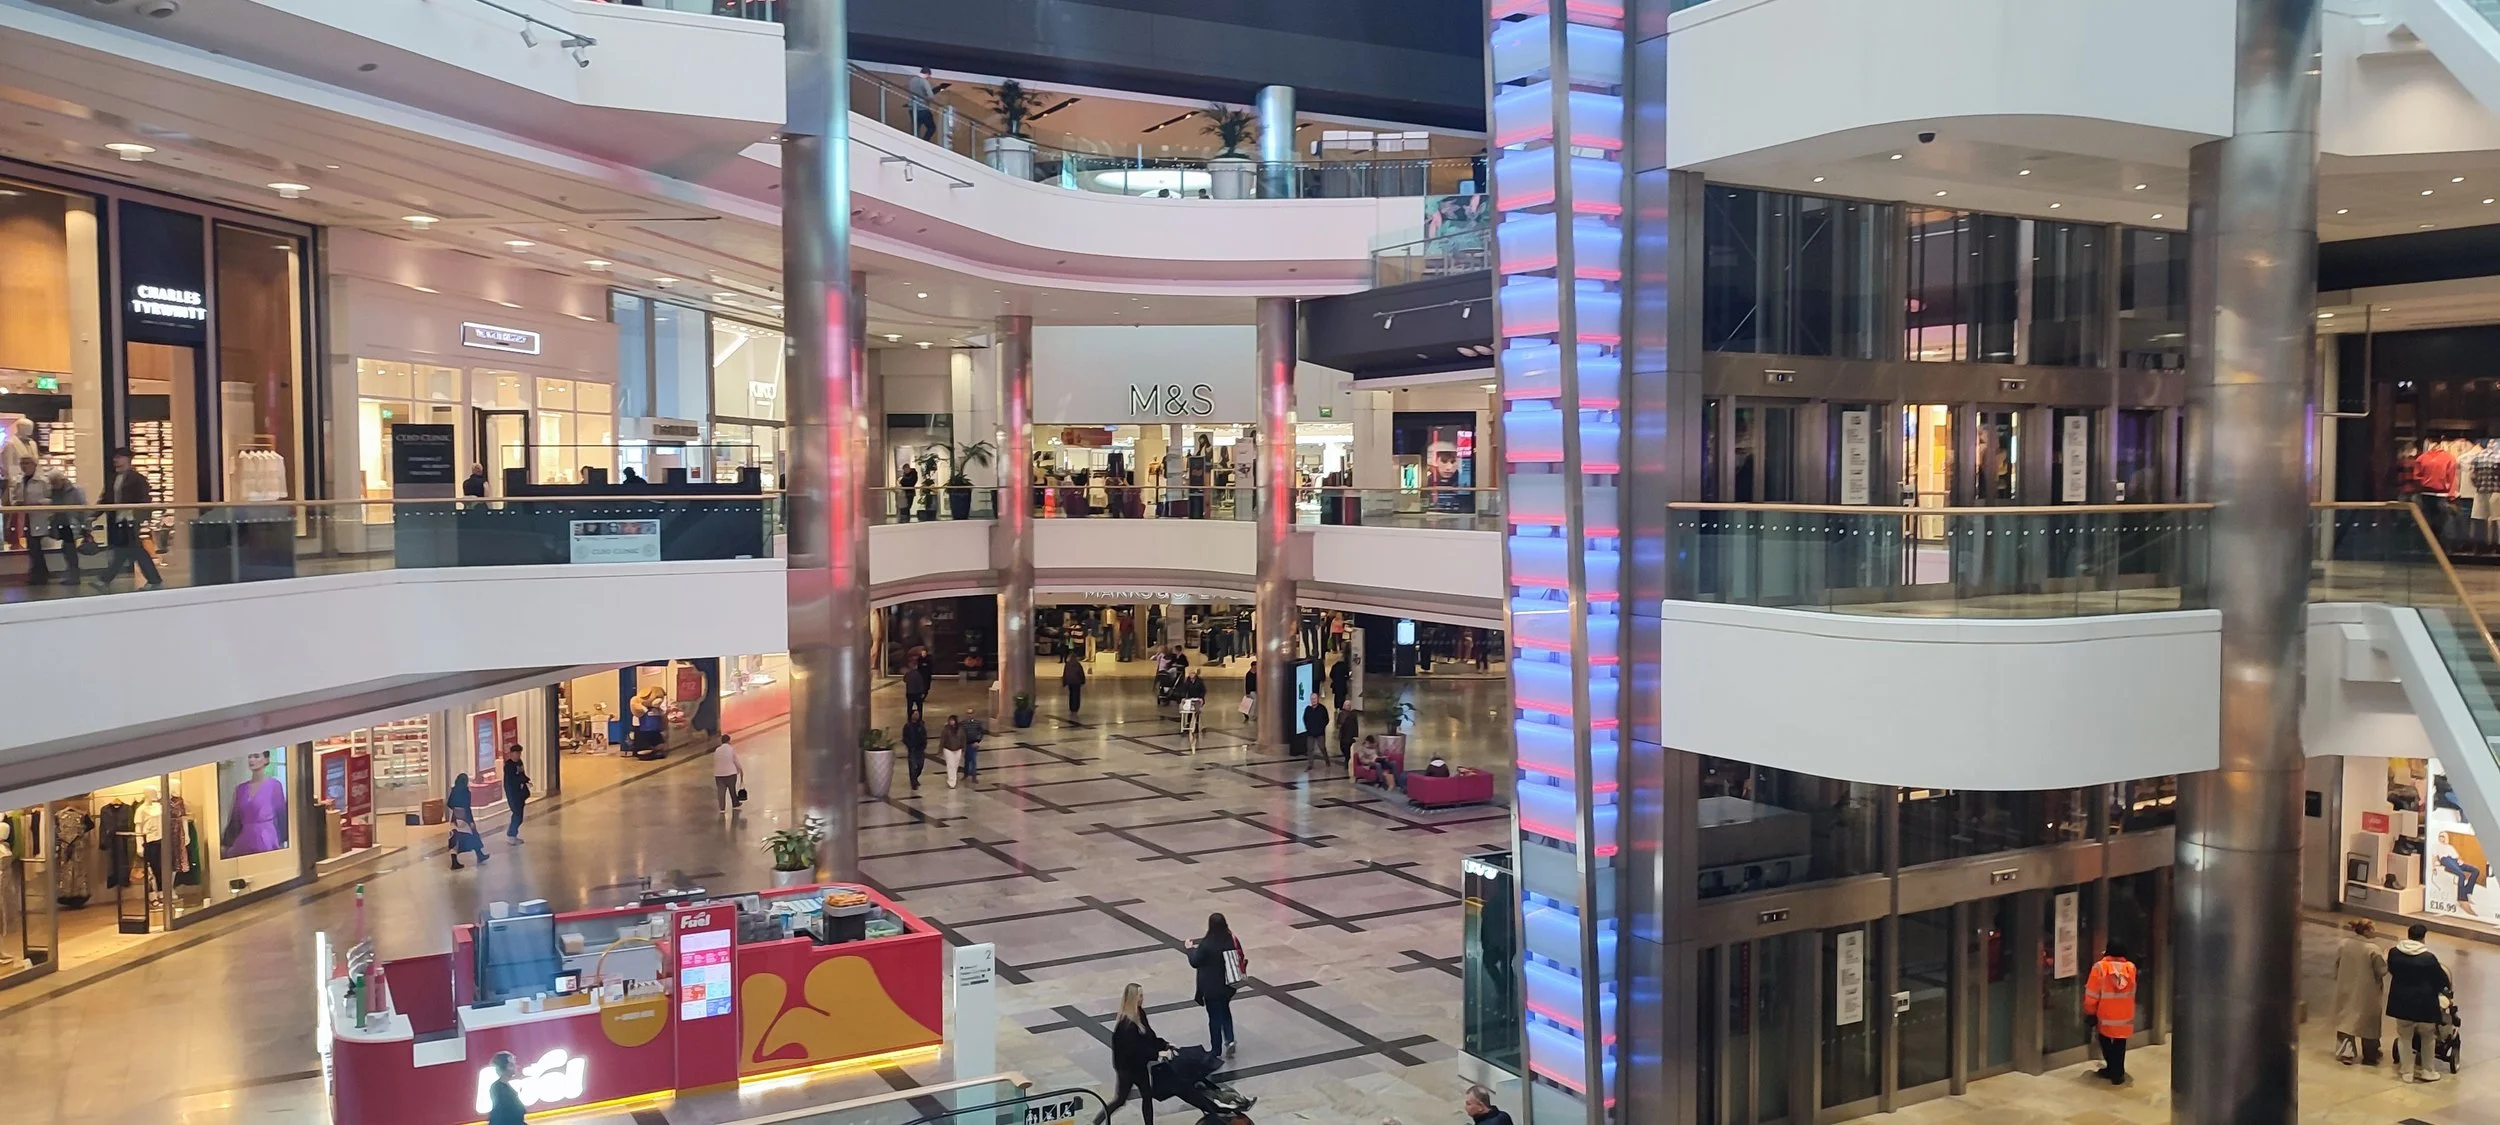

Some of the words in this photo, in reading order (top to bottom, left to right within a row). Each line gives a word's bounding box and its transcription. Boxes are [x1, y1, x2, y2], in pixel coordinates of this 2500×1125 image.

[137, 284, 202, 305] CHARLES
[131, 299, 208, 321] TYRWHITT
[1128, 383, 1215, 417] M&S
[2430, 900, 2457, 913] £16.99
[680, 913, 711, 930] Fuel
[985, 949, 992, 960] 2
